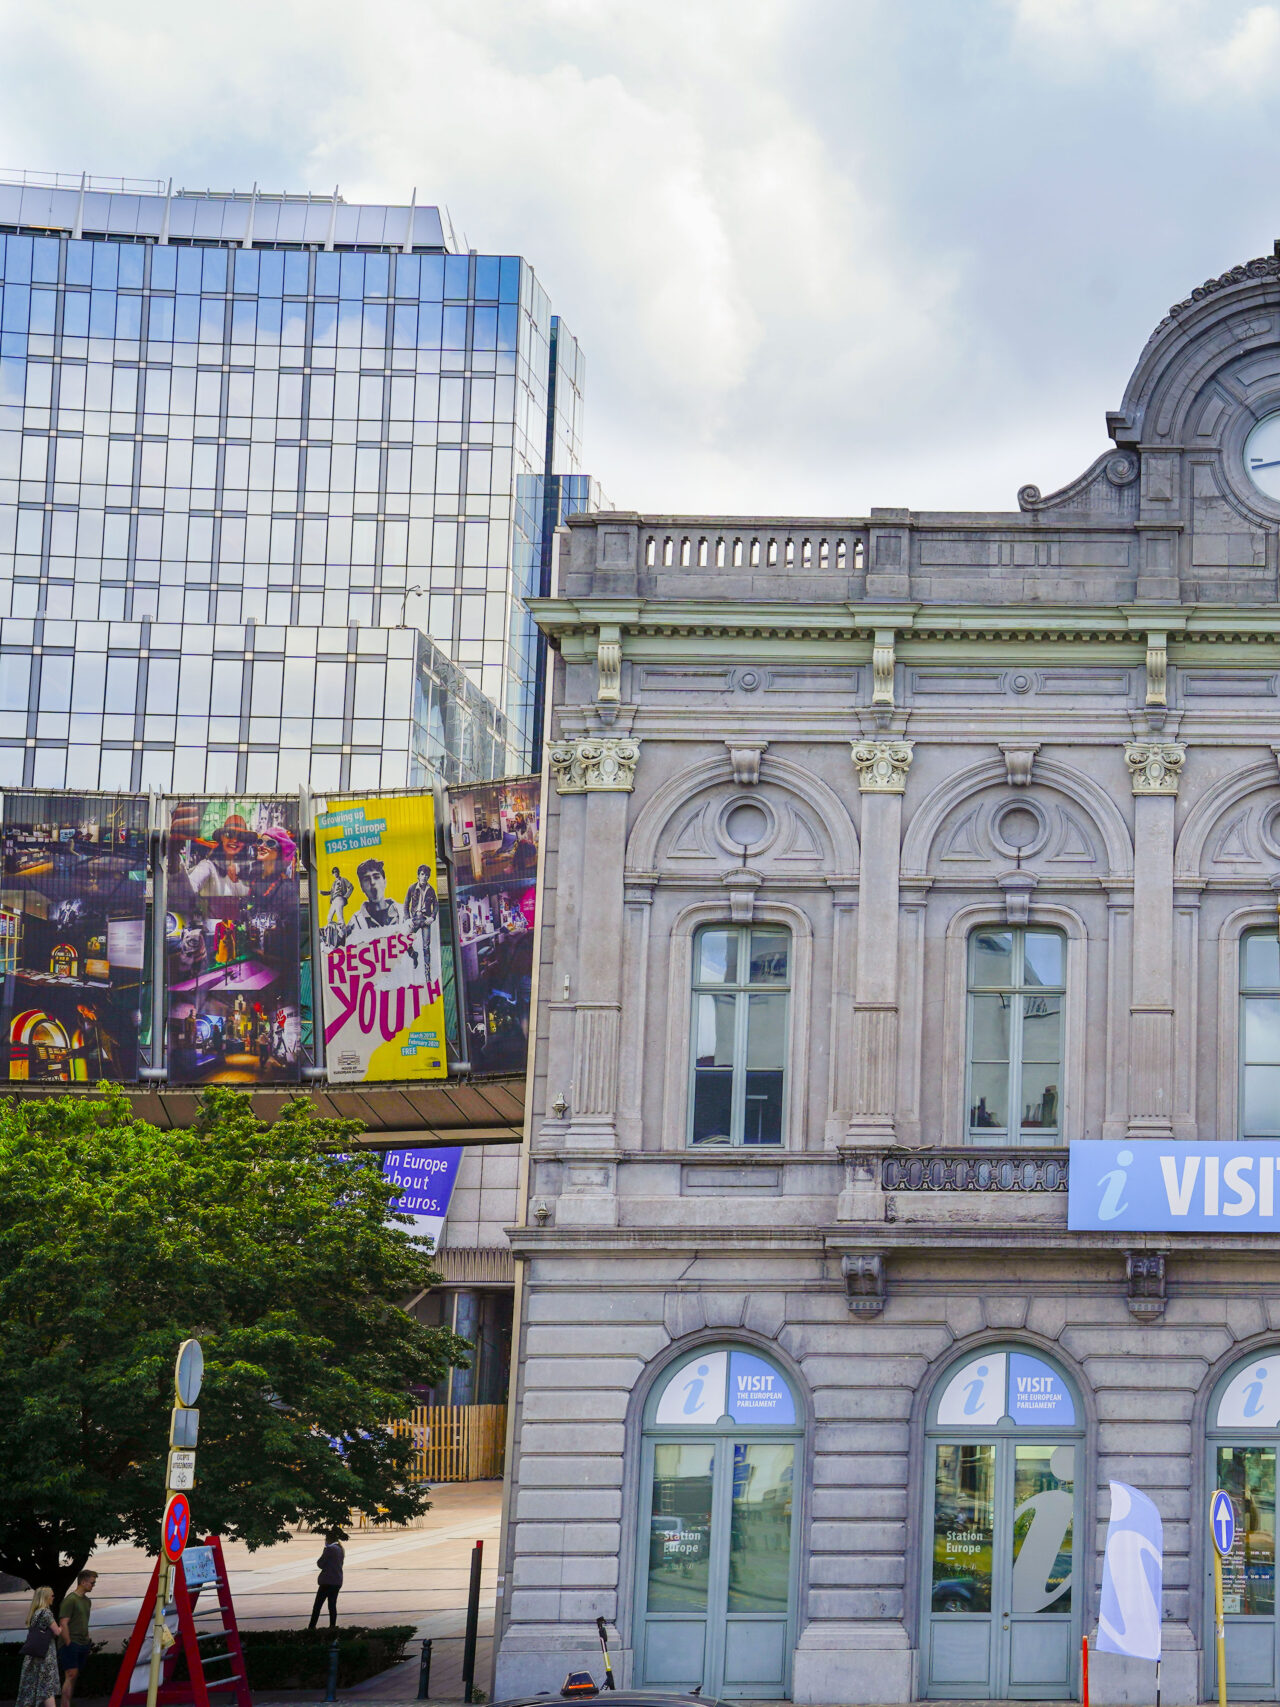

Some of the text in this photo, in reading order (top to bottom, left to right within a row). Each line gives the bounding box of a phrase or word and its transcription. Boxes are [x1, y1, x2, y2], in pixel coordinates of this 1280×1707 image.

[321, 810, 364, 825] Growing up
[344, 822, 386, 836] in Europe
[327, 836, 380, 853] 1945 to Now
[328, 933, 414, 984] RESTLESS
[324, 974, 441, 1045] YOUTH
[401, 1047, 417, 1056] FREE
[386, 1151, 448, 1175] in Europe
[383, 1170, 429, 1190] about
[398, 1196, 441, 1211] euros.
[737, 1375, 774, 1391] VISIT
[1017, 1377, 1054, 1392] VISIT
[737, 1400, 776, 1408] PARLIAMENT
[663, 1530, 701, 1541] Station
[946, 1530, 983, 1541] Station
[663, 1543, 699, 1555] Europe
[946, 1543, 981, 1555] Europe
